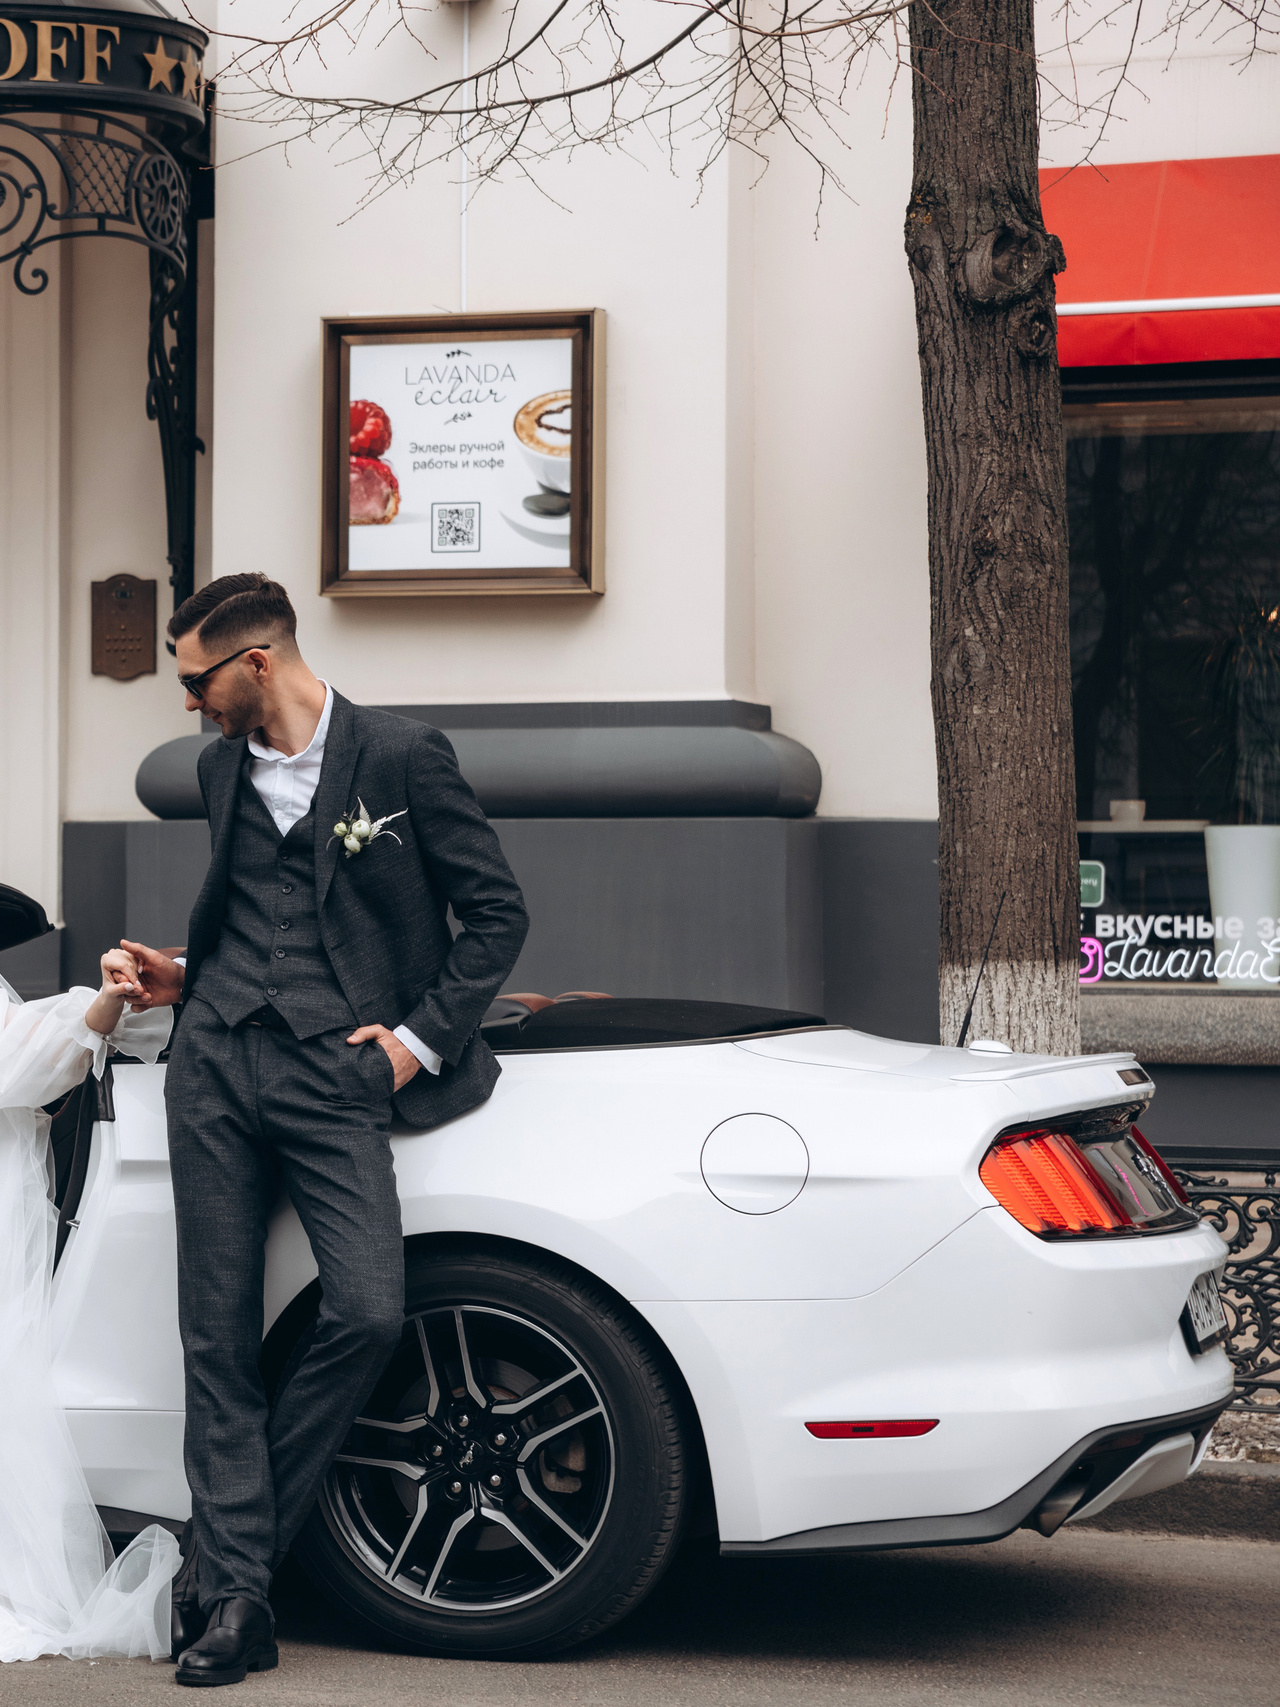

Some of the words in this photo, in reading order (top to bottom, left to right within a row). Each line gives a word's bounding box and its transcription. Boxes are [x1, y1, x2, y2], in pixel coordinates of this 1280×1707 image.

[404, 363, 517, 386] LAVANDA
[409, 442, 456, 455] Эклеры
[459, 440, 505, 455] ручной
[413, 458, 458, 472] работы
[462, 460, 469, 468] и
[473, 457, 505, 470] кофе
[1095, 914, 1245, 946] вкусные
[1256, 915, 1280, 940] з
